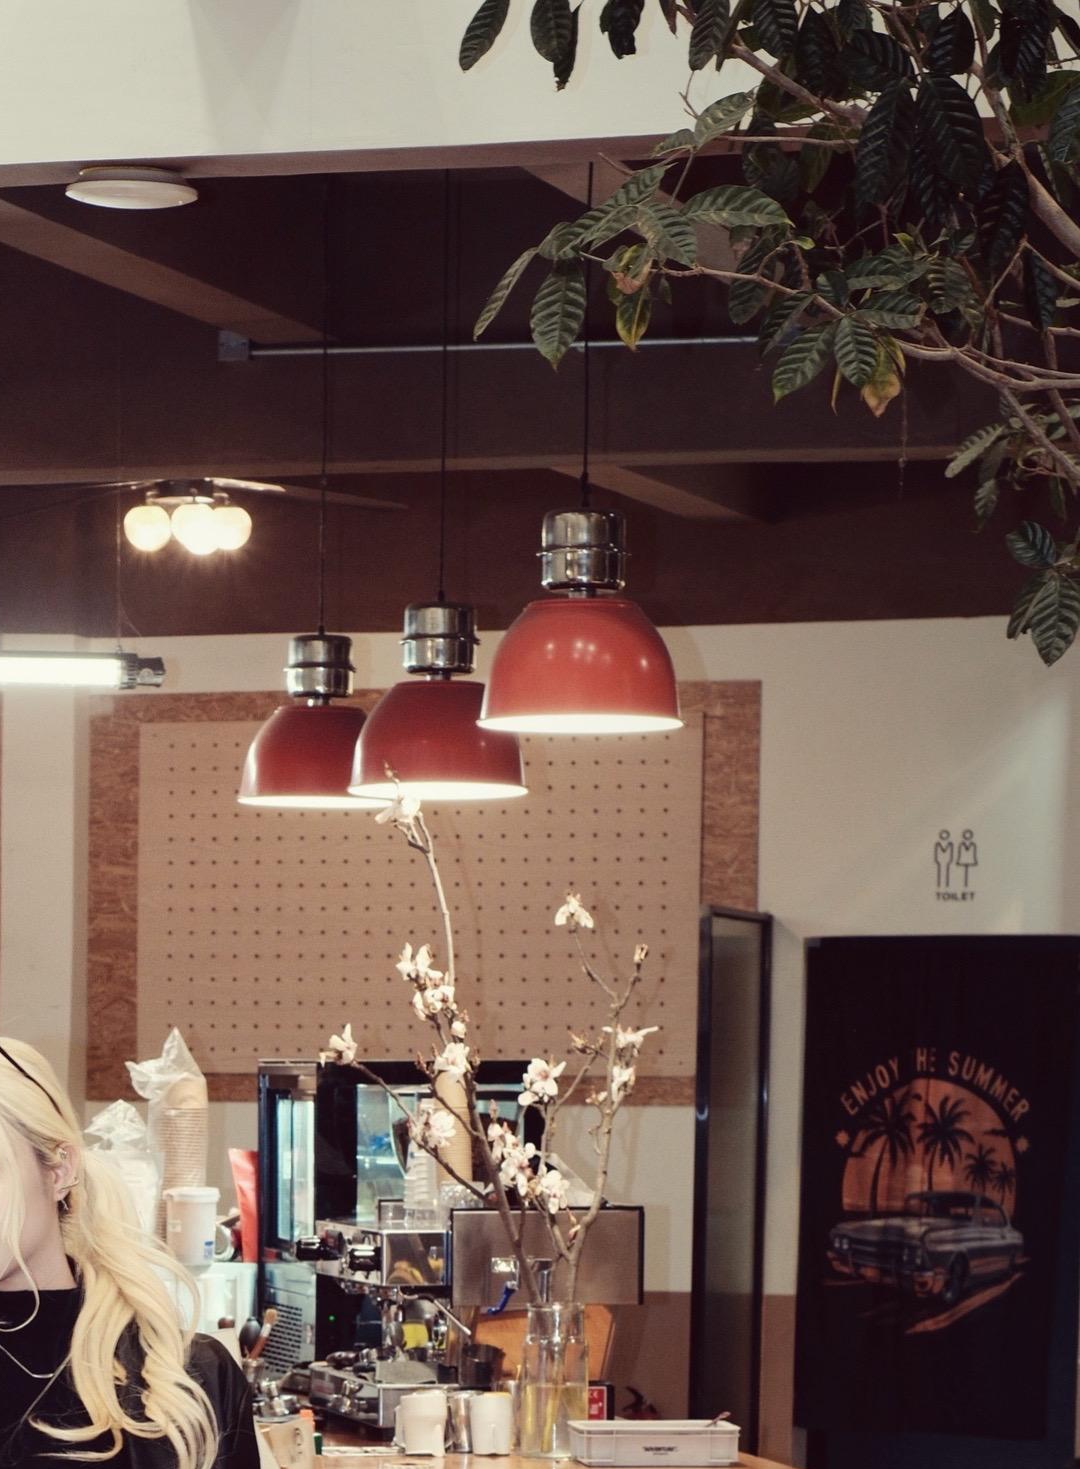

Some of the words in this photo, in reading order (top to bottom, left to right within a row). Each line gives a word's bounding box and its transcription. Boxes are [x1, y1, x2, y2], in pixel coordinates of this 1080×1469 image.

[936, 891, 975, 901] TOILET
[840, 1055, 900, 1116] ENJOY
[948, 1050, 1030, 1122] SUMMER
